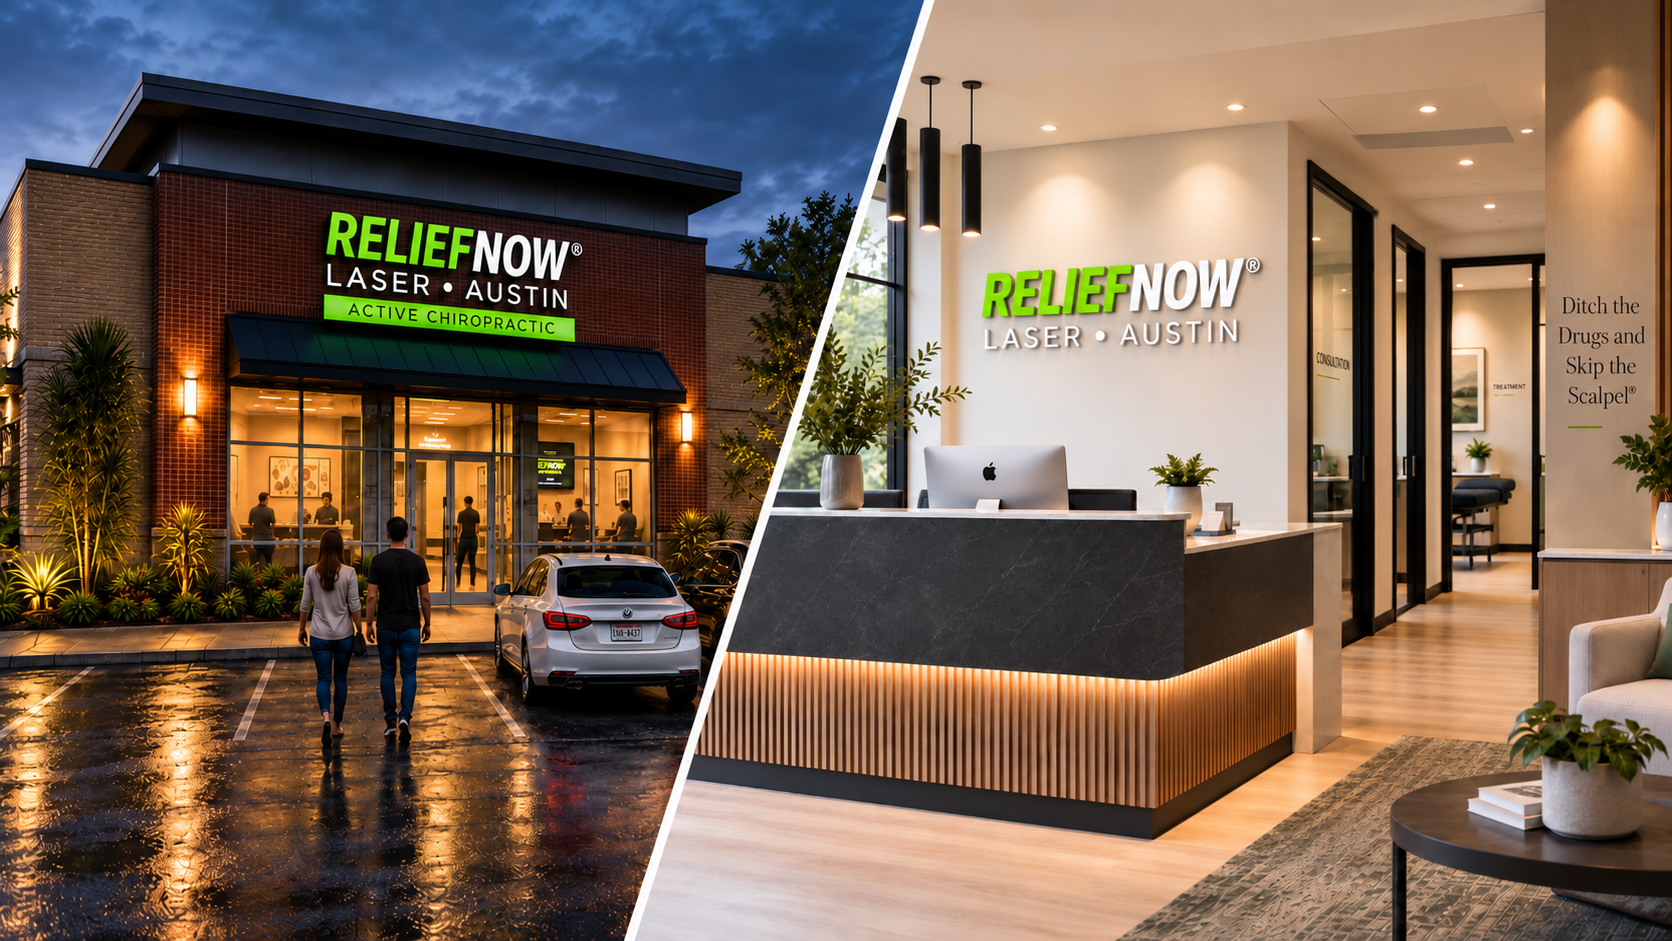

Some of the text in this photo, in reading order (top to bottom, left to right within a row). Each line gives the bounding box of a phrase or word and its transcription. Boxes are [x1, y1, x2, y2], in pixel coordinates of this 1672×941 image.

[326, 263, 568, 310] LASER AUSTIN
[1562, 296, 1640, 314] Ditch the
[348, 302, 556, 335] ACTIVE CHIROPRACTIC
[984, 319, 1238, 350] LASER AUSTIN
[1558, 326, 1645, 349] Drugs and
[1316, 351, 1351, 371] CONSULTATION
[1566, 356, 1637, 379] Skip the
